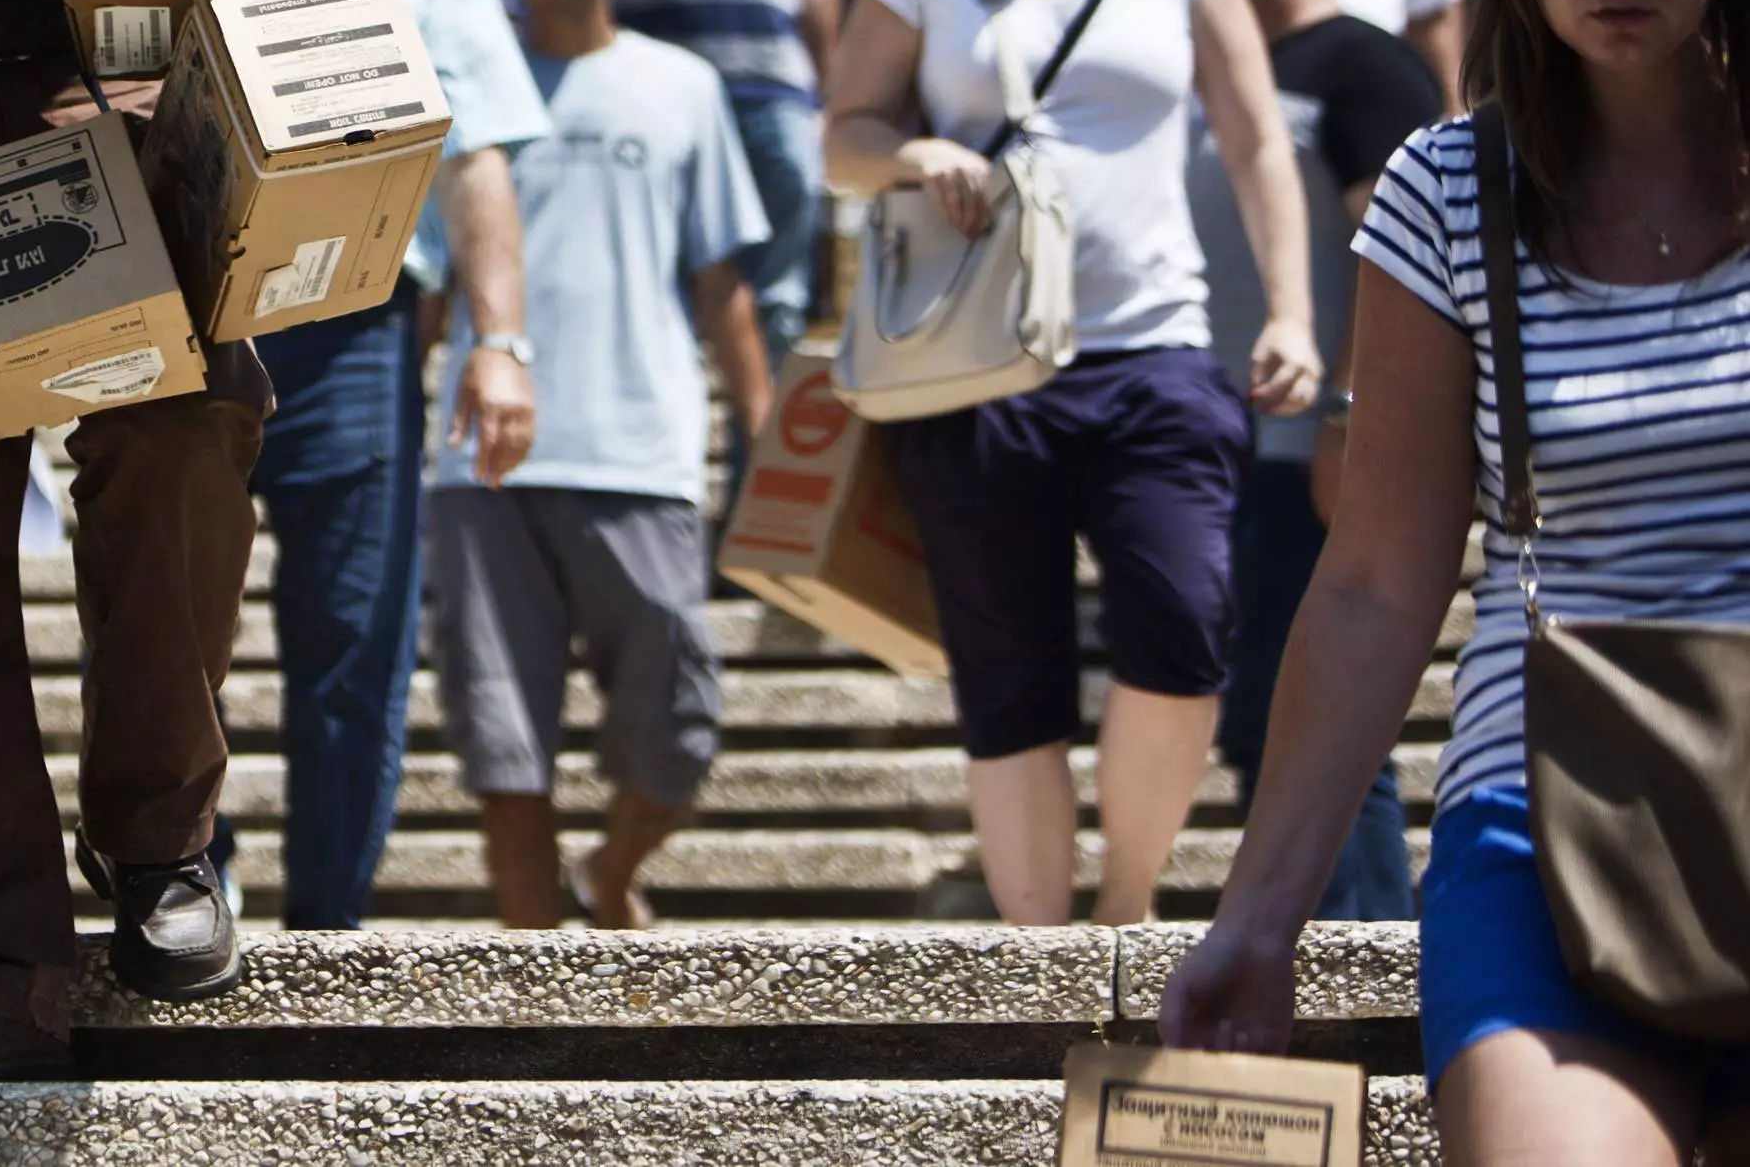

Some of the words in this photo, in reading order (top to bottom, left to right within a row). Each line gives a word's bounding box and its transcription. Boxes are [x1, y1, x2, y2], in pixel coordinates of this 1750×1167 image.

[340, 72, 360, 83] NOT
[364, 69, 379, 78] DO
[304, 76, 335, 89] OPEN!
[14, 246, 46, 272] מגן
